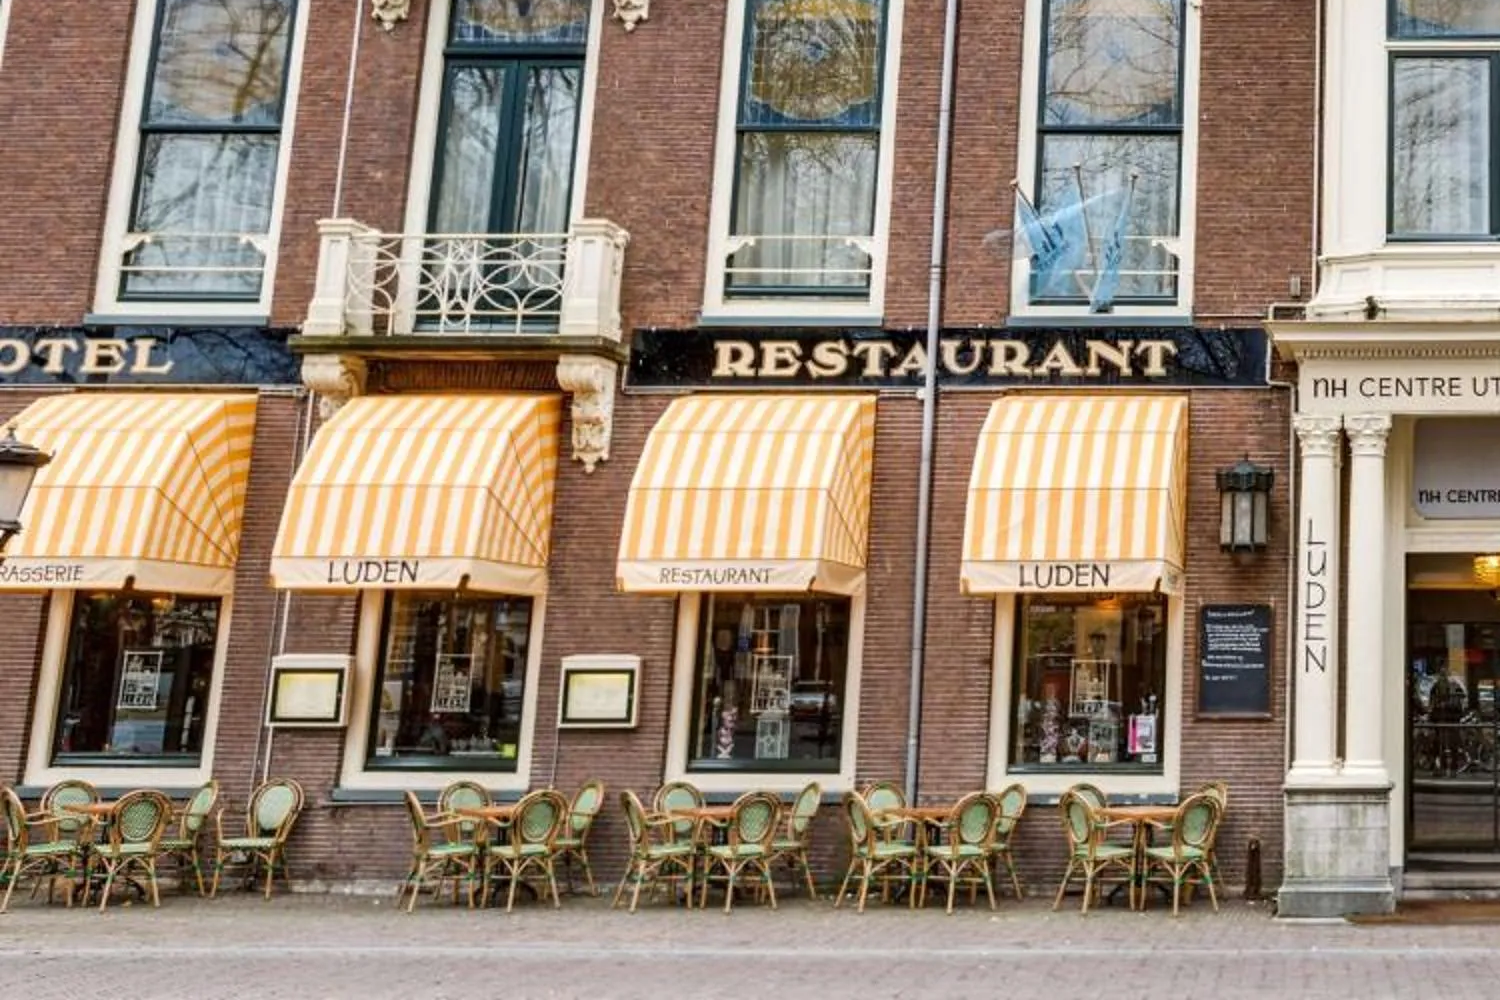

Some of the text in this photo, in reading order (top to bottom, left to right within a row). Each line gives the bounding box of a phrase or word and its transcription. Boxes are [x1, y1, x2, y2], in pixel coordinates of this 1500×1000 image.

[0, 338, 174, 375] OTEL
[711, 338, 1179, 378] RESTAURANT
[1358, 377, 1463, 398] CENTRE
[327, 559, 420, 585] LUDEN
[659, 567, 775, 585] RESTAURANT
[1018, 563, 1112, 588] LUDEN
[1304, 518, 1328, 674] LUDEN
